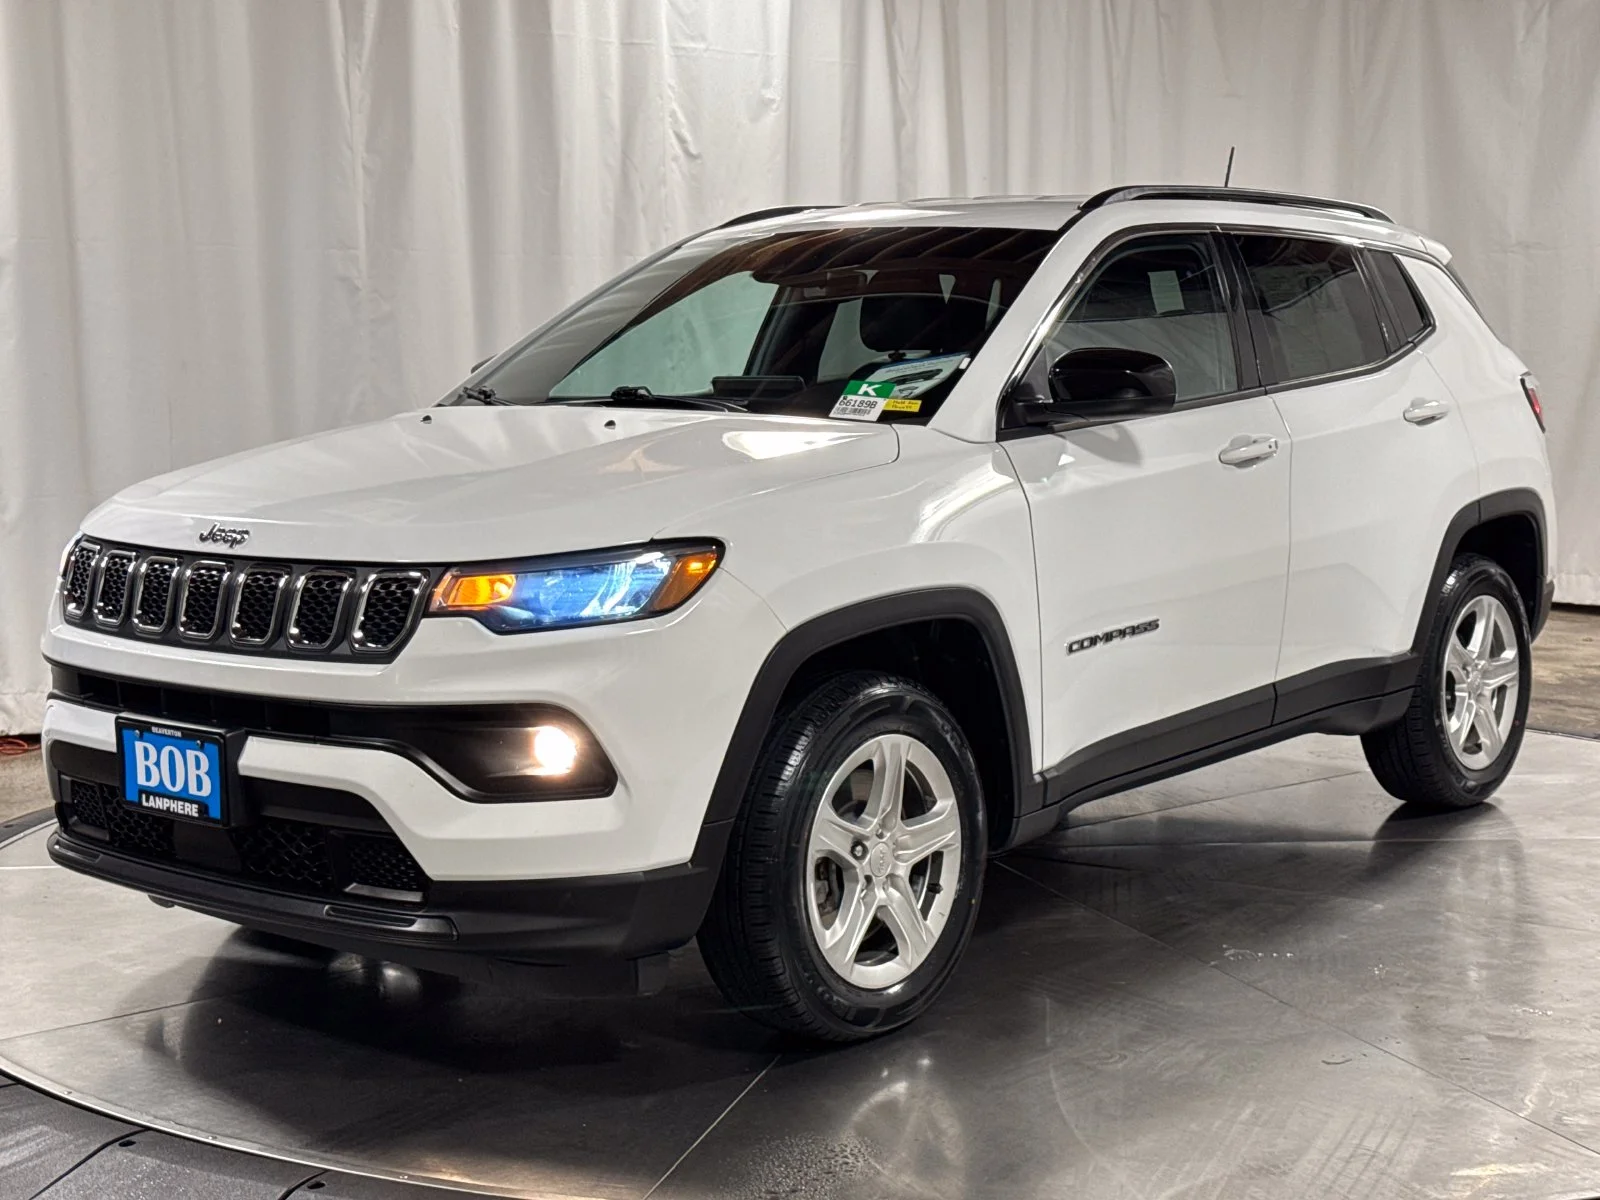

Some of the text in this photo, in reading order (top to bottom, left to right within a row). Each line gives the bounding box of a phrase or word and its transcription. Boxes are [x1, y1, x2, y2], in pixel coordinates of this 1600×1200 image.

[857, 383, 882, 396] K
[838, 398, 878, 409] 66189B
[199, 522, 251, 548] Jeep
[1066, 618, 1160, 655] COMPASS
[151, 726, 182, 738] BEAVERTON
[134, 740, 212, 797] BOB
[141, 793, 199, 817] LANPHERE
